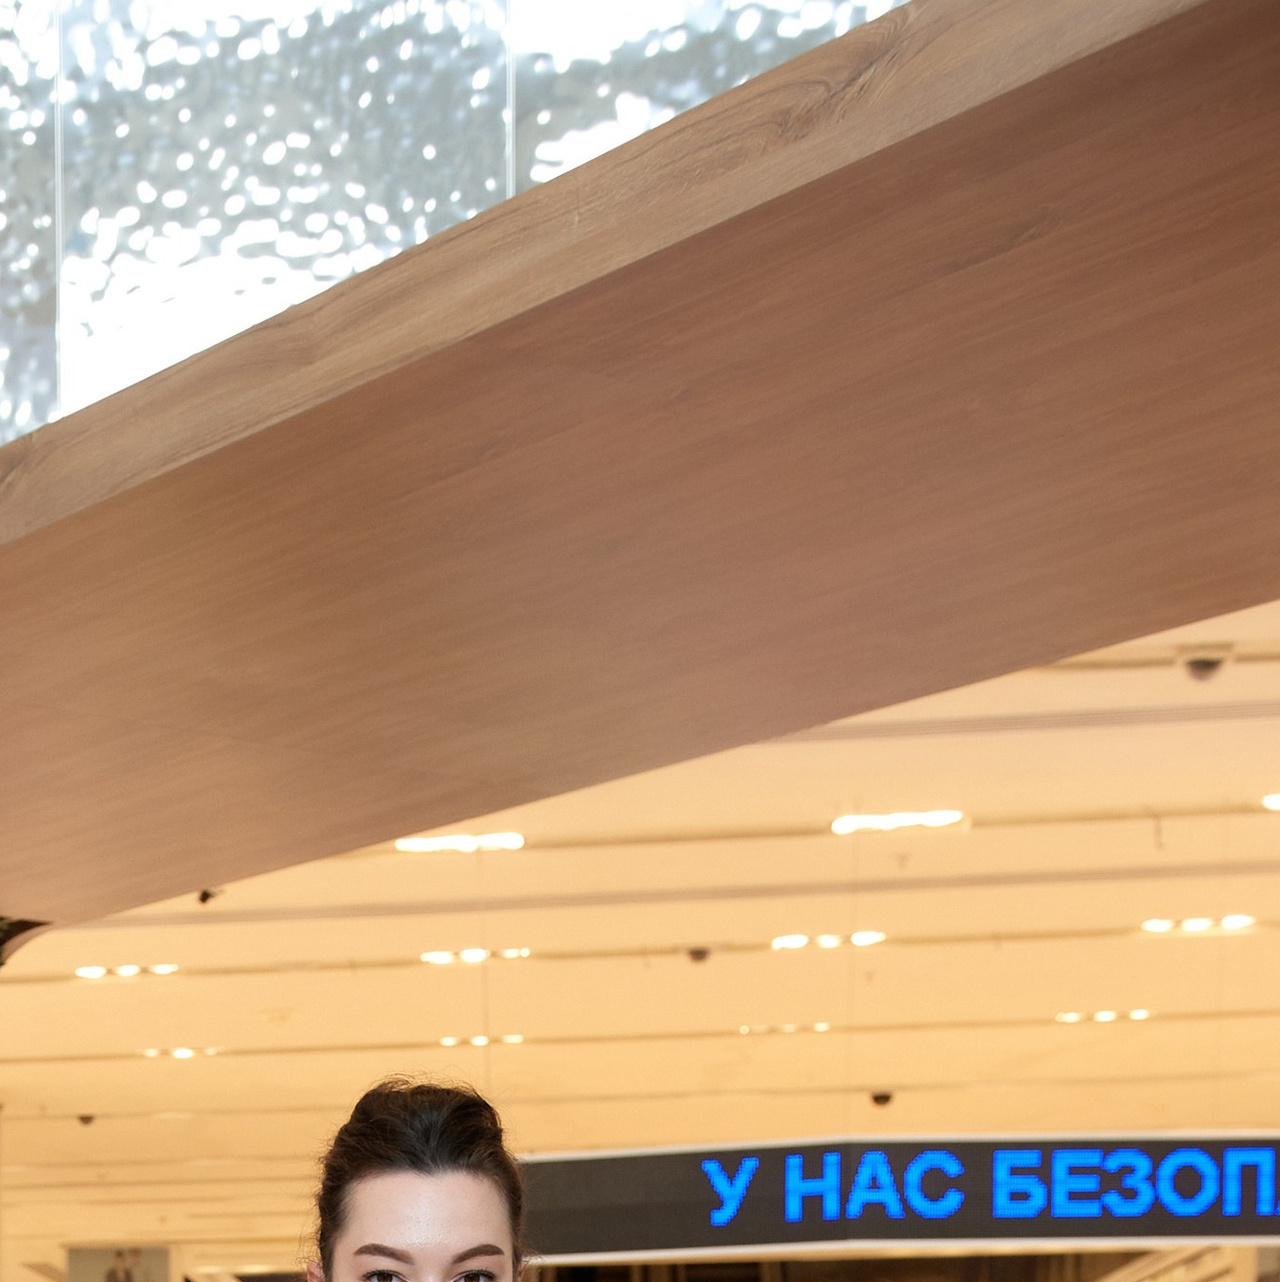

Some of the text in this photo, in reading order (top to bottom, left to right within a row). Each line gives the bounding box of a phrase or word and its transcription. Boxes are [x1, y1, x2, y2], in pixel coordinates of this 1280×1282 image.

[701, 1147, 1280, 1227] У НАС БЕЗОП
